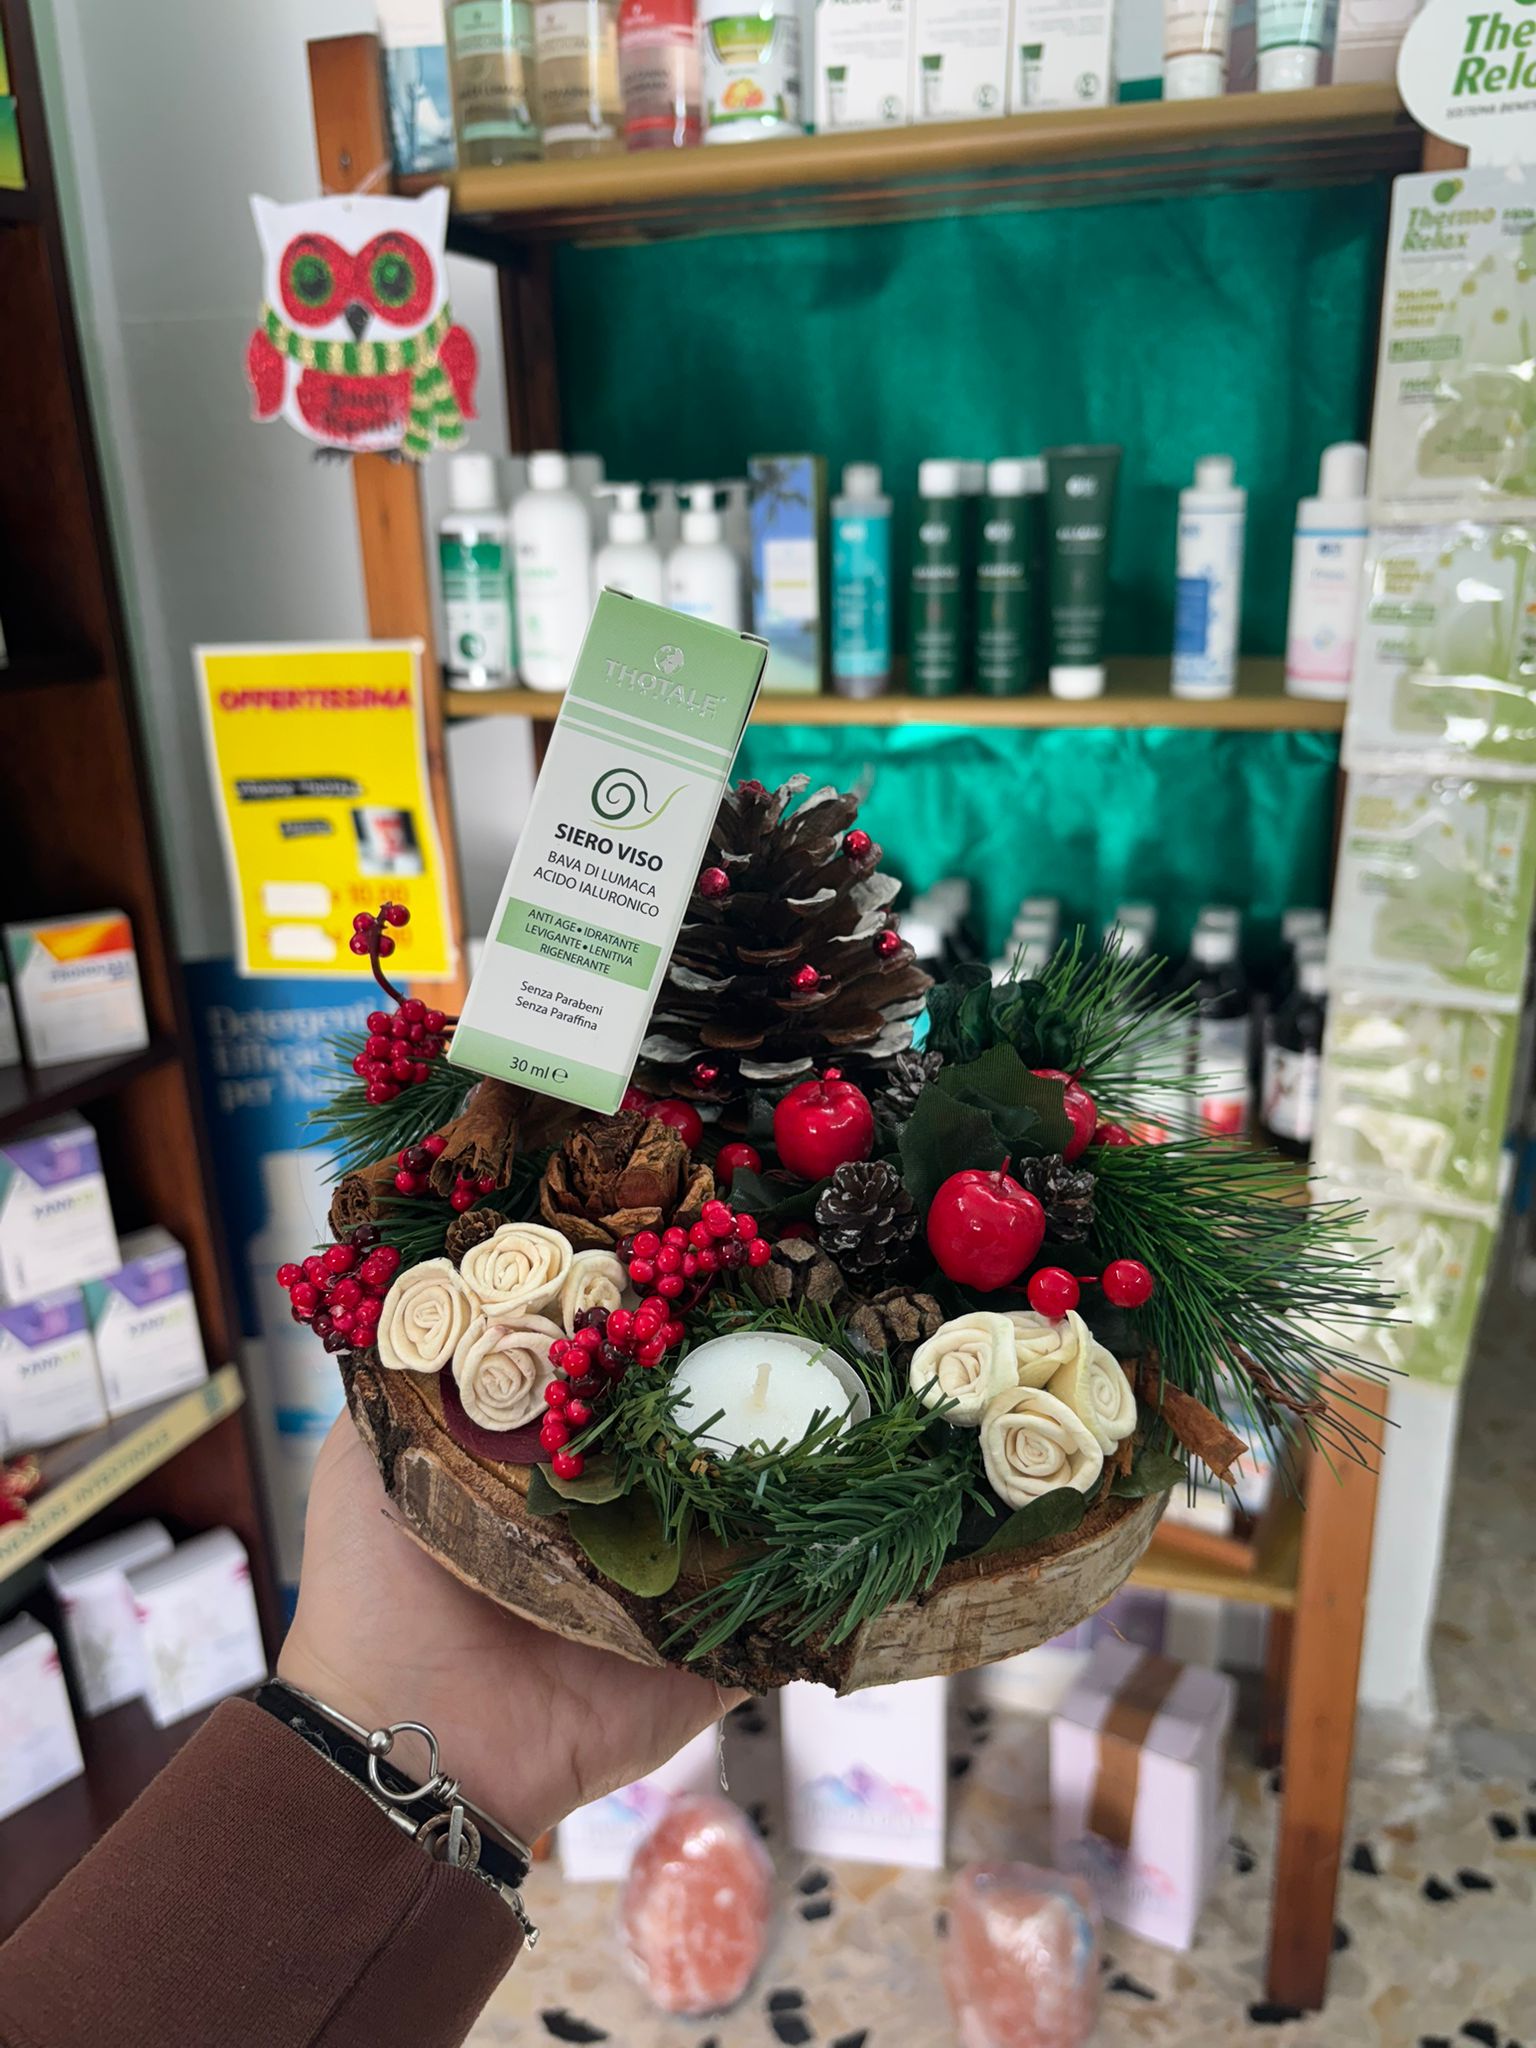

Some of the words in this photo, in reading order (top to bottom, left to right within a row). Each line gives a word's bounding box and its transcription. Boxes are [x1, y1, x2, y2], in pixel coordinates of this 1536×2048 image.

[554, 823, 614, 855] SIERO
[618, 843, 664, 872] VISO
[533, 866, 577, 890] ACIDO
[579, 881, 660, 918] IALURONICO
[547, 850, 582, 873] BAVA
[584, 863, 600, 878] DI
[601, 869, 657, 898] LUMACA
[525, 922, 582, 951] LEVIGANTE
[588, 943, 633, 967] LENITIVA
[528, 909, 554, 924] ANTI
[554, 917, 577, 933] AGE
[583, 927, 640, 954] IDRATANTE
[539, 943, 611, 975] RIGENERANTE
[515, 996, 549, 1016] Senza
[550, 1006, 599, 1032] Paraffina
[520, 980, 553, 1001] Senza
[554, 990, 604, 1017] Parabeni
[509, 1056, 528, 1073] 30
[530, 1062, 550, 1079] ml
